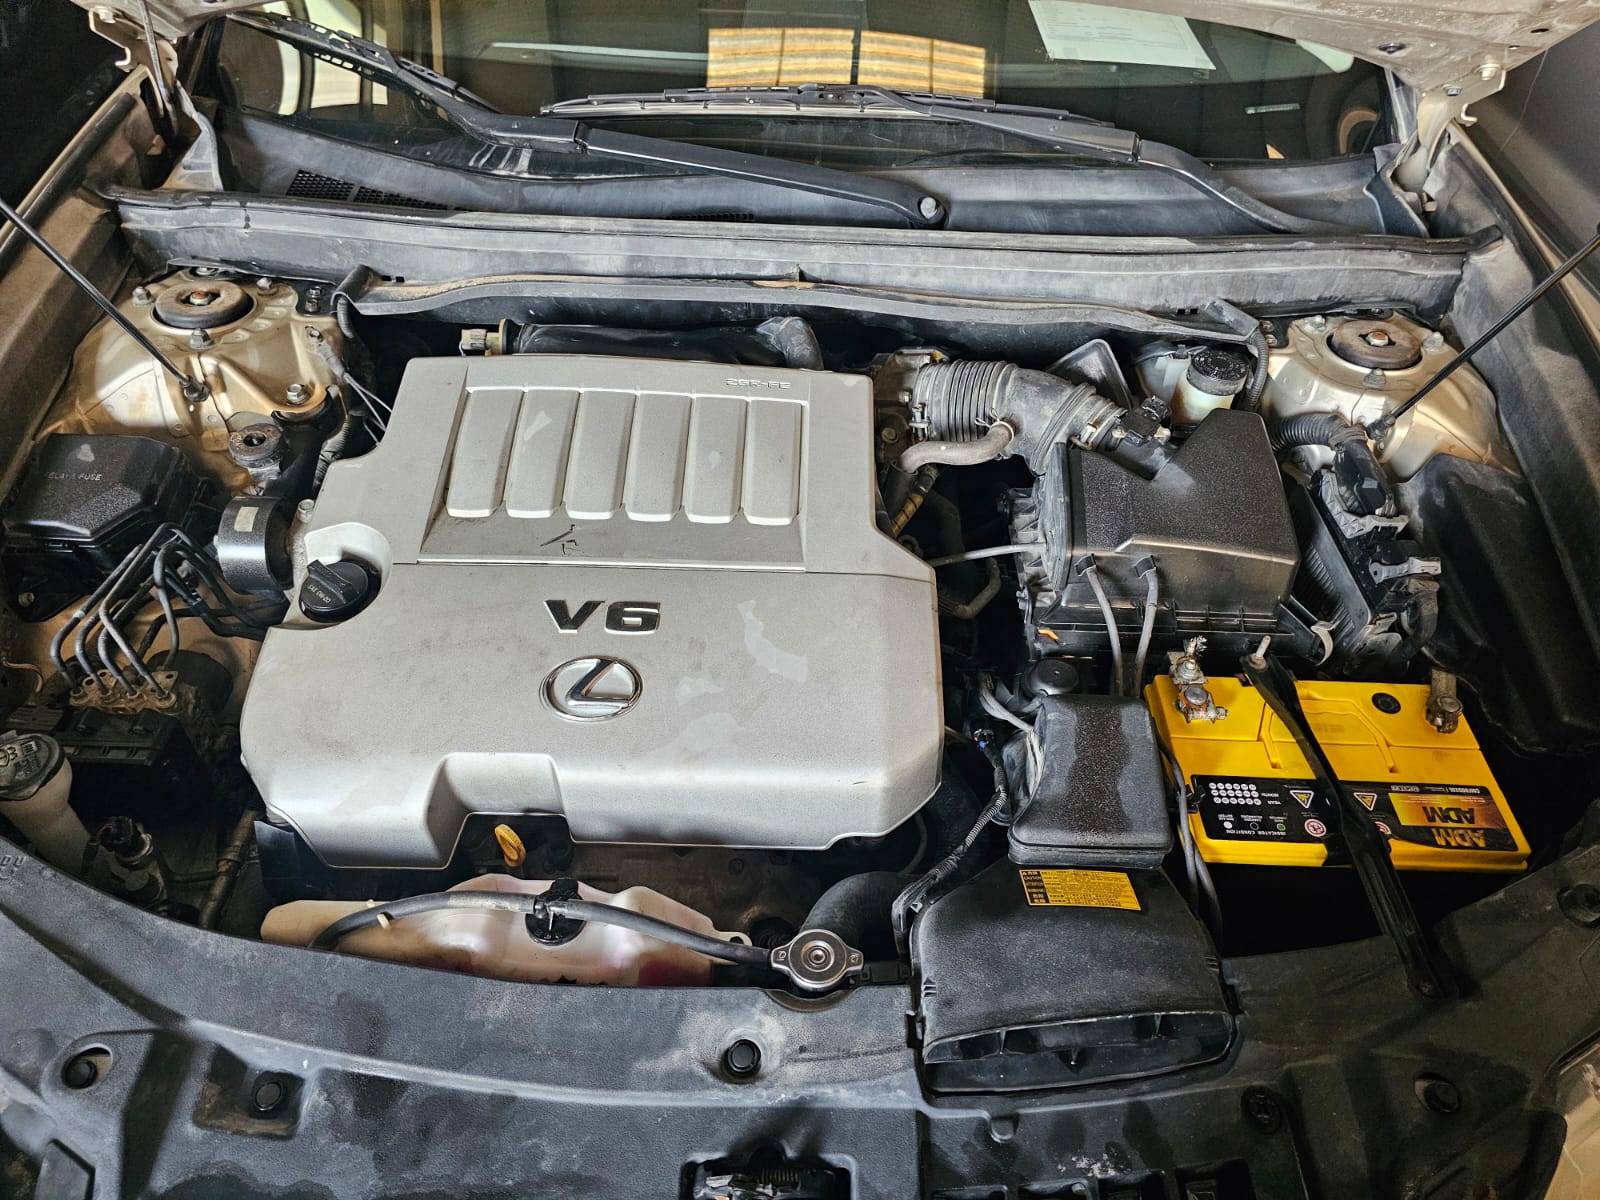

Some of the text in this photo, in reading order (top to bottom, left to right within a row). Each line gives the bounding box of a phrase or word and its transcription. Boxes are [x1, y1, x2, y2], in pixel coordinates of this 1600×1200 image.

[725, 378, 791, 389] 2GR-FE
[78, 472, 103, 481] FUSE
[543, 599, 661, 635] V6
[1422, 805, 1476, 825] ADM
[1431, 828, 1487, 848] ADM
